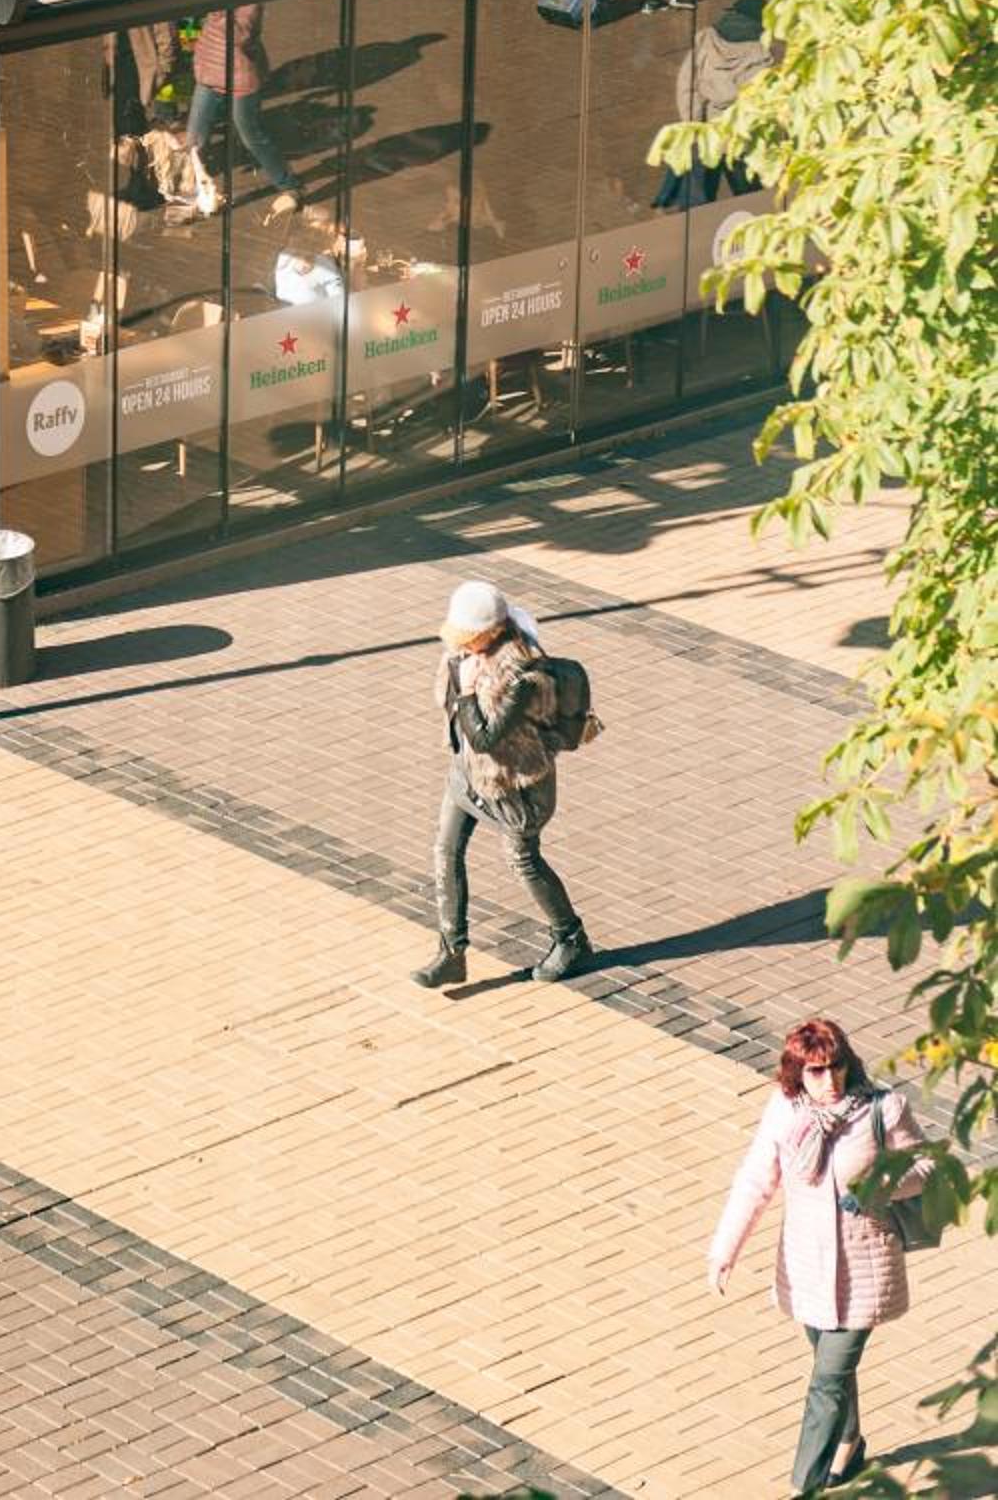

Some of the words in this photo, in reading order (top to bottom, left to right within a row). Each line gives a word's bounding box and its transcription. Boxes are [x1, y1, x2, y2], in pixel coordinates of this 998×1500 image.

[480, 303, 509, 328] OPEN
[511, 299, 526, 320] 24
[527, 291, 562, 316] HOURS
[363, 328, 438, 359] Heineken
[250, 359, 327, 390] Heineken
[121, 390, 153, 415] OPEN
[155, 387, 171, 407] 24
[173, 375, 212, 402] HOURS
[33, 404, 79, 432] Raffy
